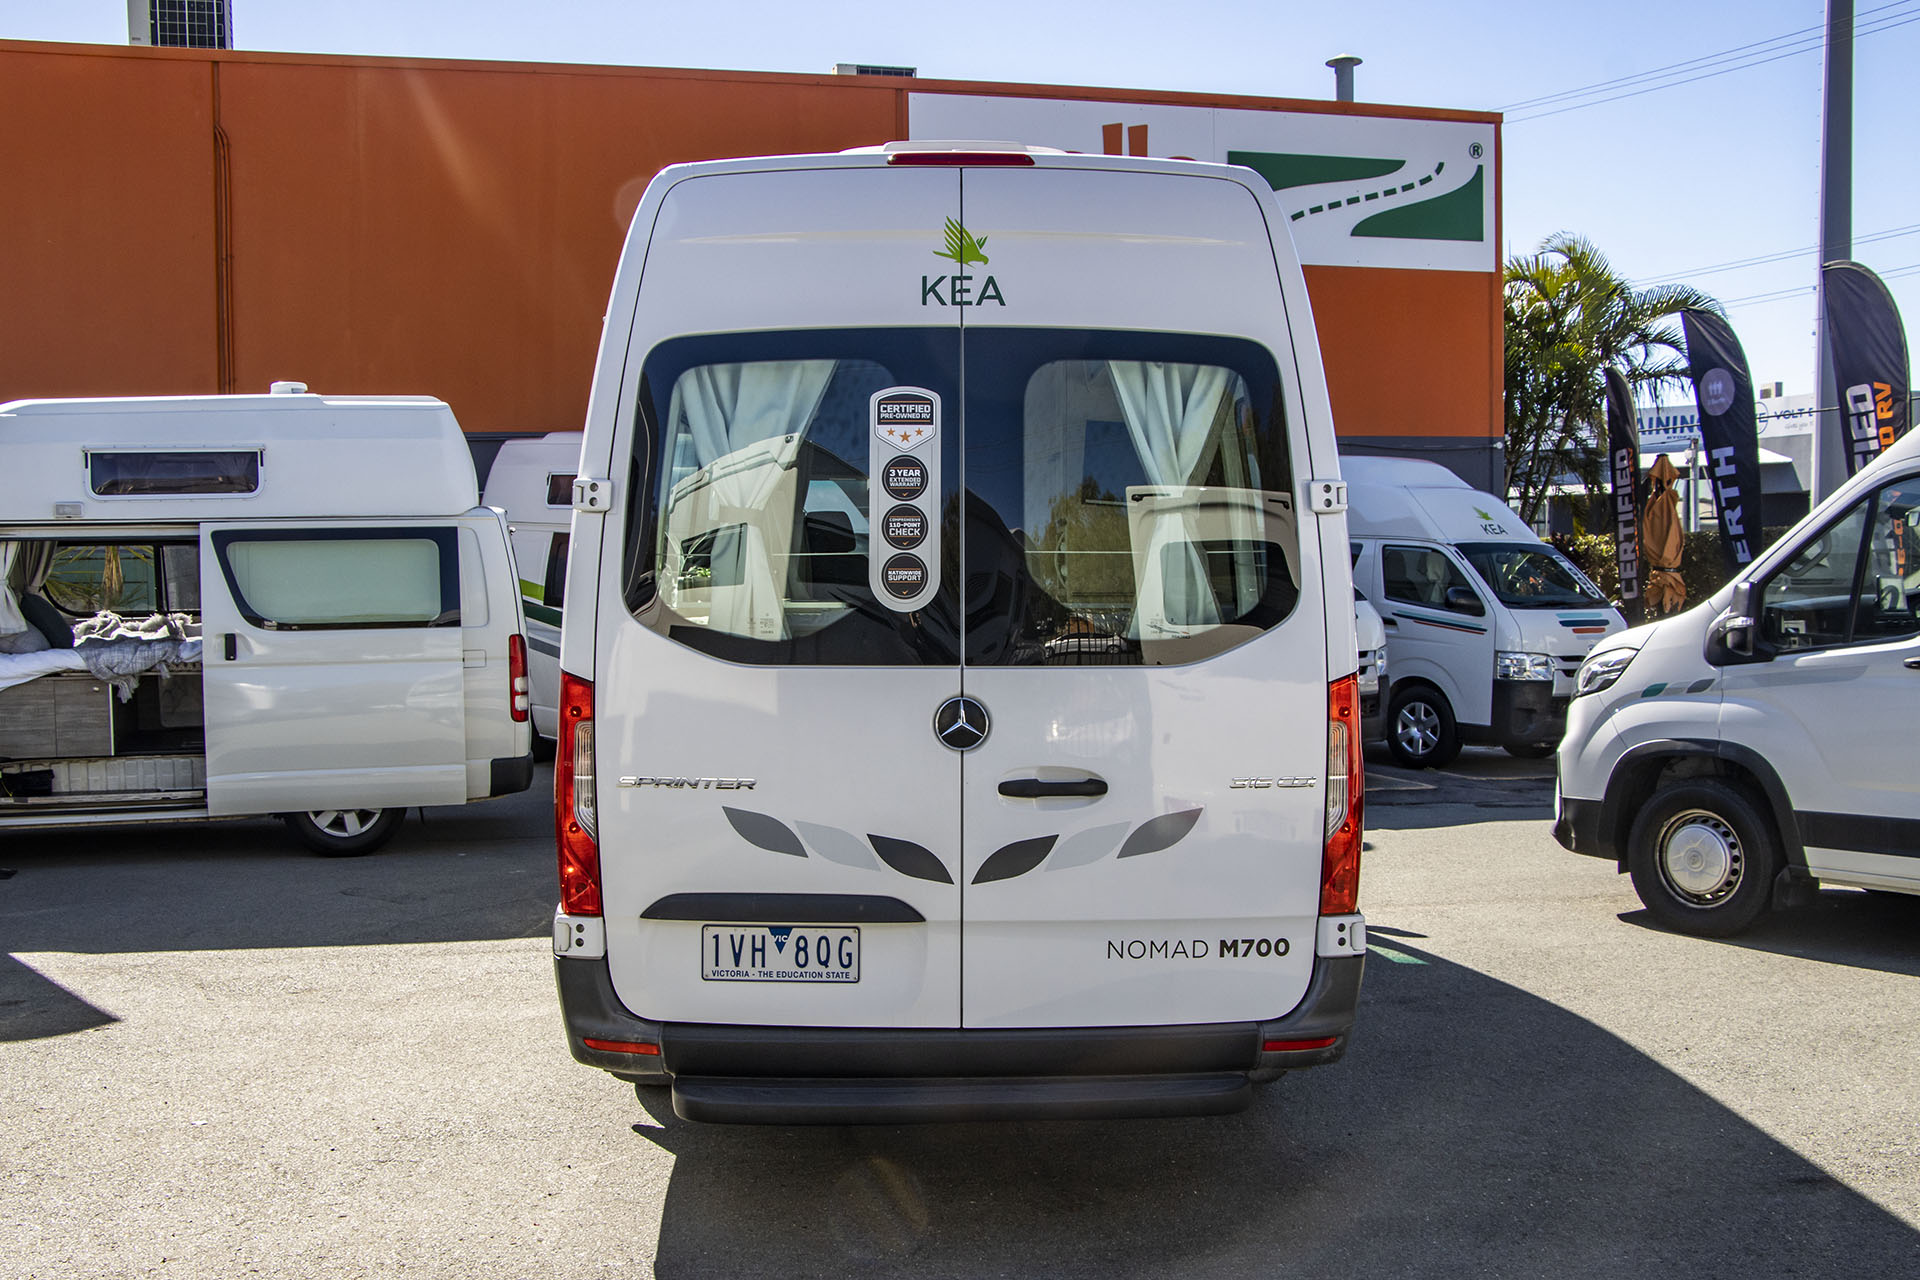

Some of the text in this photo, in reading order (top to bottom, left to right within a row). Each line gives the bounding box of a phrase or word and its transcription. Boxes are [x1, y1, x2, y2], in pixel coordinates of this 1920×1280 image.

[922, 275, 1006, 306] KEA
[1873, 381, 1894, 420] RV
[880, 404, 931, 413] CERTIFIED
[889, 469, 921, 477] 3 YEAR
[1480, 524, 1508, 535] KEA
[1615, 448, 1638, 600] CERTIFIED
[889, 528, 921, 536] CHECK
[617, 776, 757, 790] SPRINTER
[1277, 776, 1317, 788] CDI
[712, 933, 853, 969] 1VH 8QG
[1107, 938, 1290, 959] NOMAD M700
[711, 969, 750, 977] VICTORIA
[757, 970, 774, 978] THE
[776, 971, 823, 979] EDUCATION
[825, 971, 850, 979] STATE
